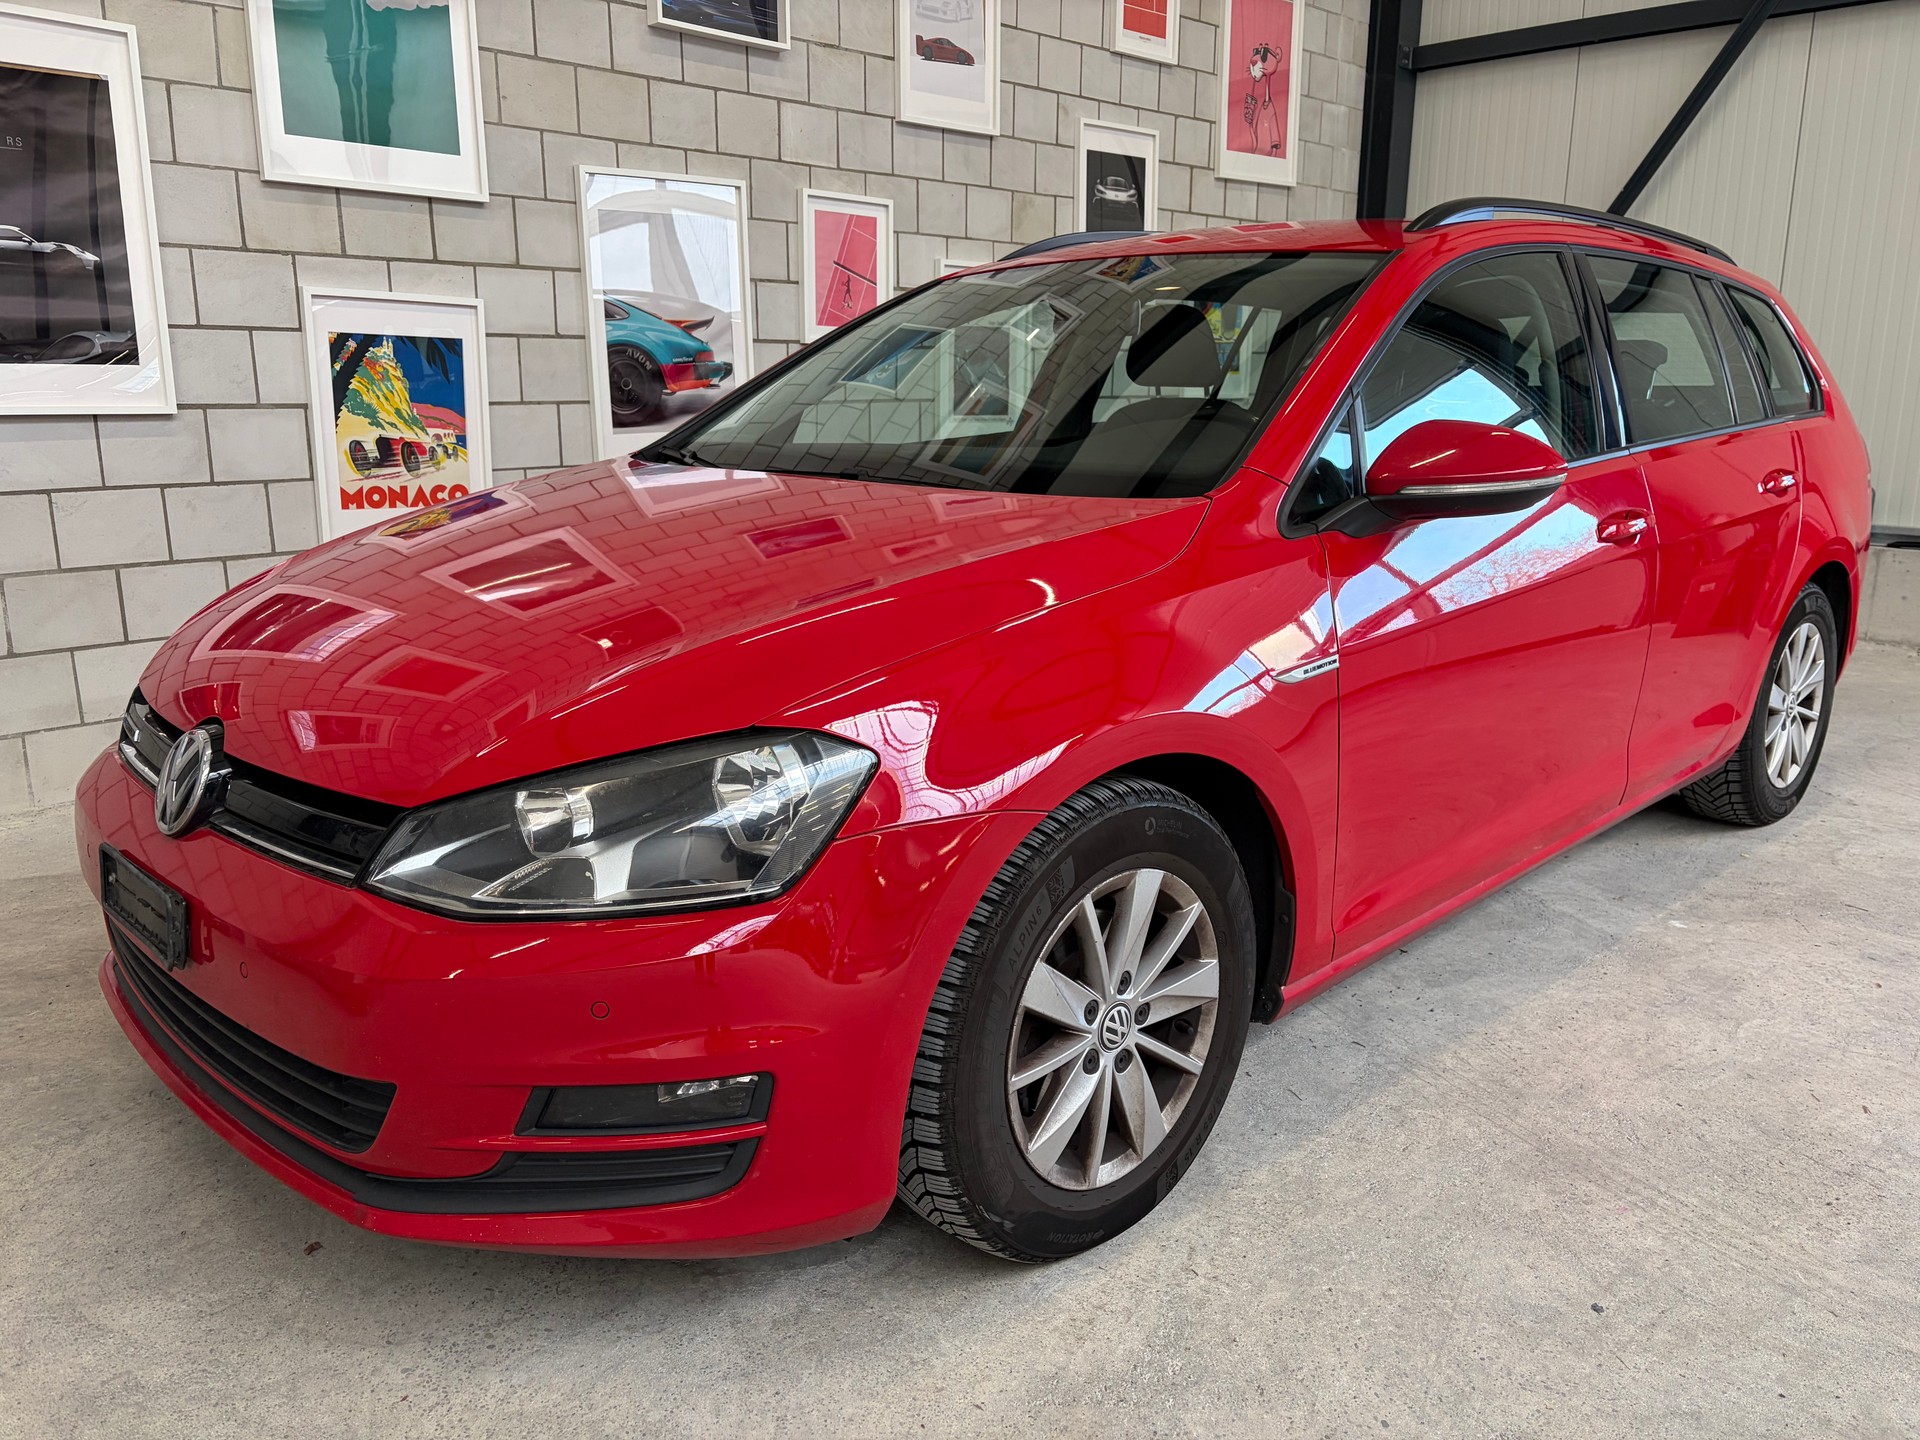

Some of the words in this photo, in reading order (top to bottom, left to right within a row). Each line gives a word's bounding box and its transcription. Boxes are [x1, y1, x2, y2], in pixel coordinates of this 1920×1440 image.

[6, 136, 23, 147] RS
[626, 348, 652, 370] AVON
[340, 484, 470, 510] MONACO
[1303, 659, 1337, 675] BLUEMOTION
[1008, 914, 1038, 973] ALPIN
[1036, 905, 1042, 916] 6
